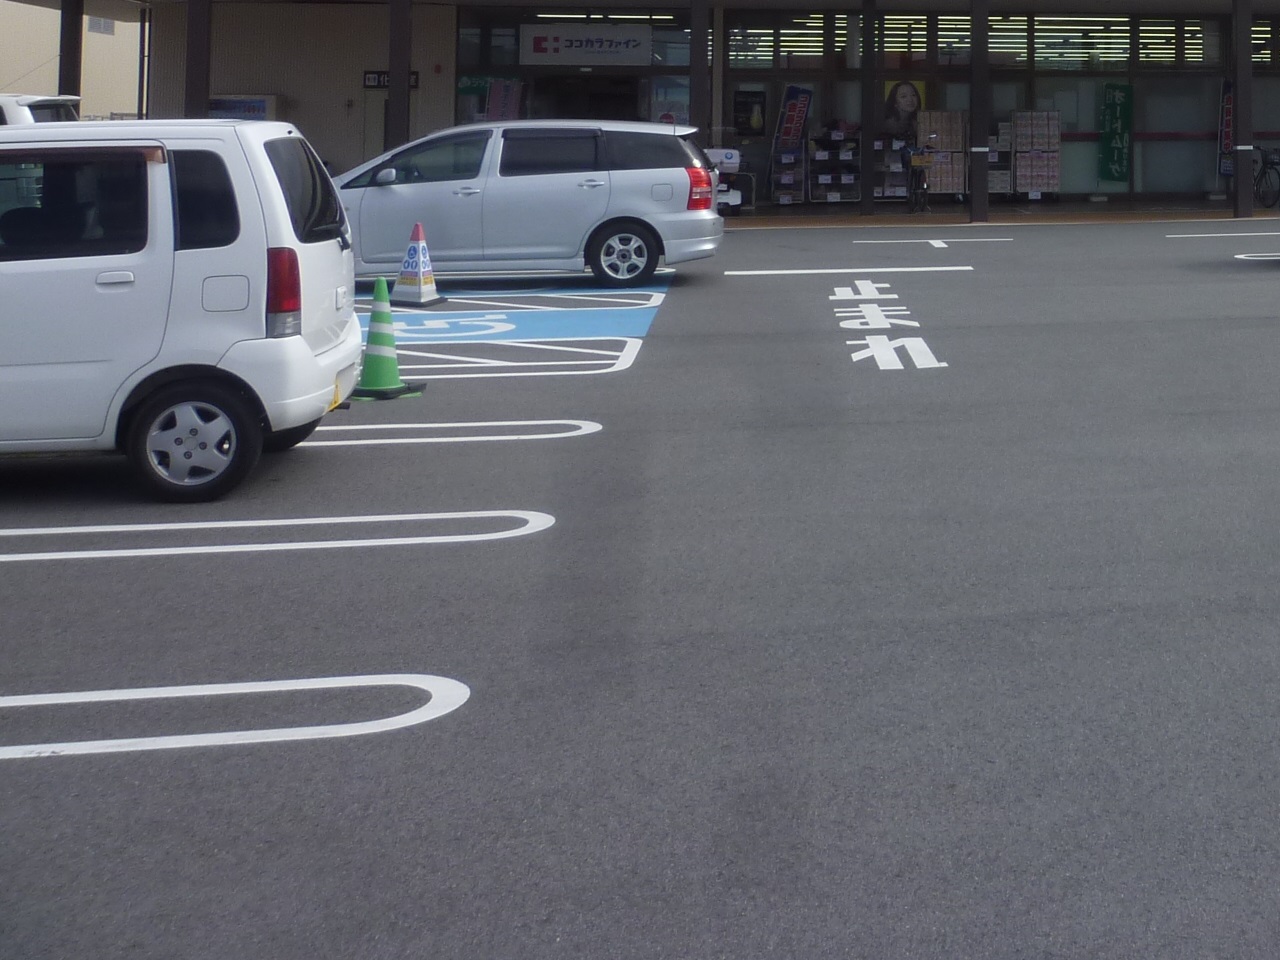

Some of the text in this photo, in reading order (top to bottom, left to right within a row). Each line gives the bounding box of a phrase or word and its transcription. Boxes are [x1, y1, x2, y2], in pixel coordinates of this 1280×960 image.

[564, 37, 641, 49] ココカラファイン
[828, 280, 949, 370] 止まれ
